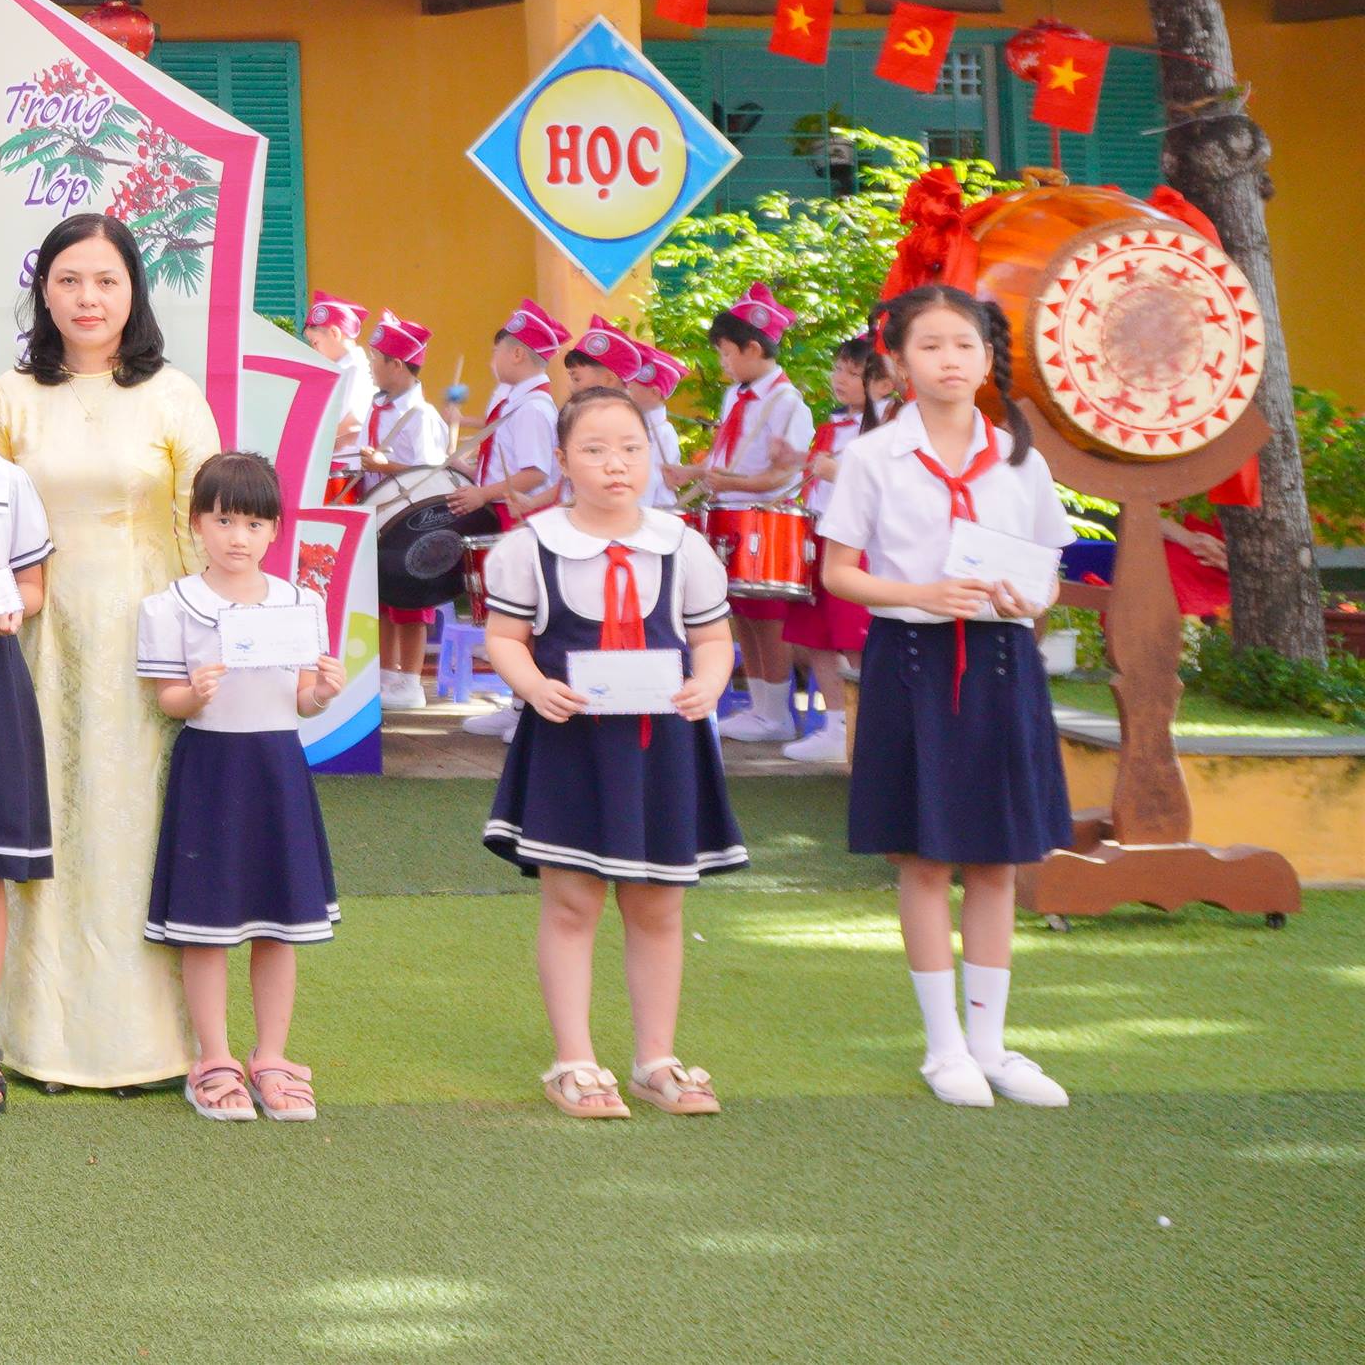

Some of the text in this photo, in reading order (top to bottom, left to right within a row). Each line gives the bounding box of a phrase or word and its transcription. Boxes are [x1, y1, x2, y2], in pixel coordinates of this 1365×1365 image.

[6, 82, 111, 135] Trong
[545, 124, 661, 201] HỌC
[24, 166, 90, 218] Lớp
